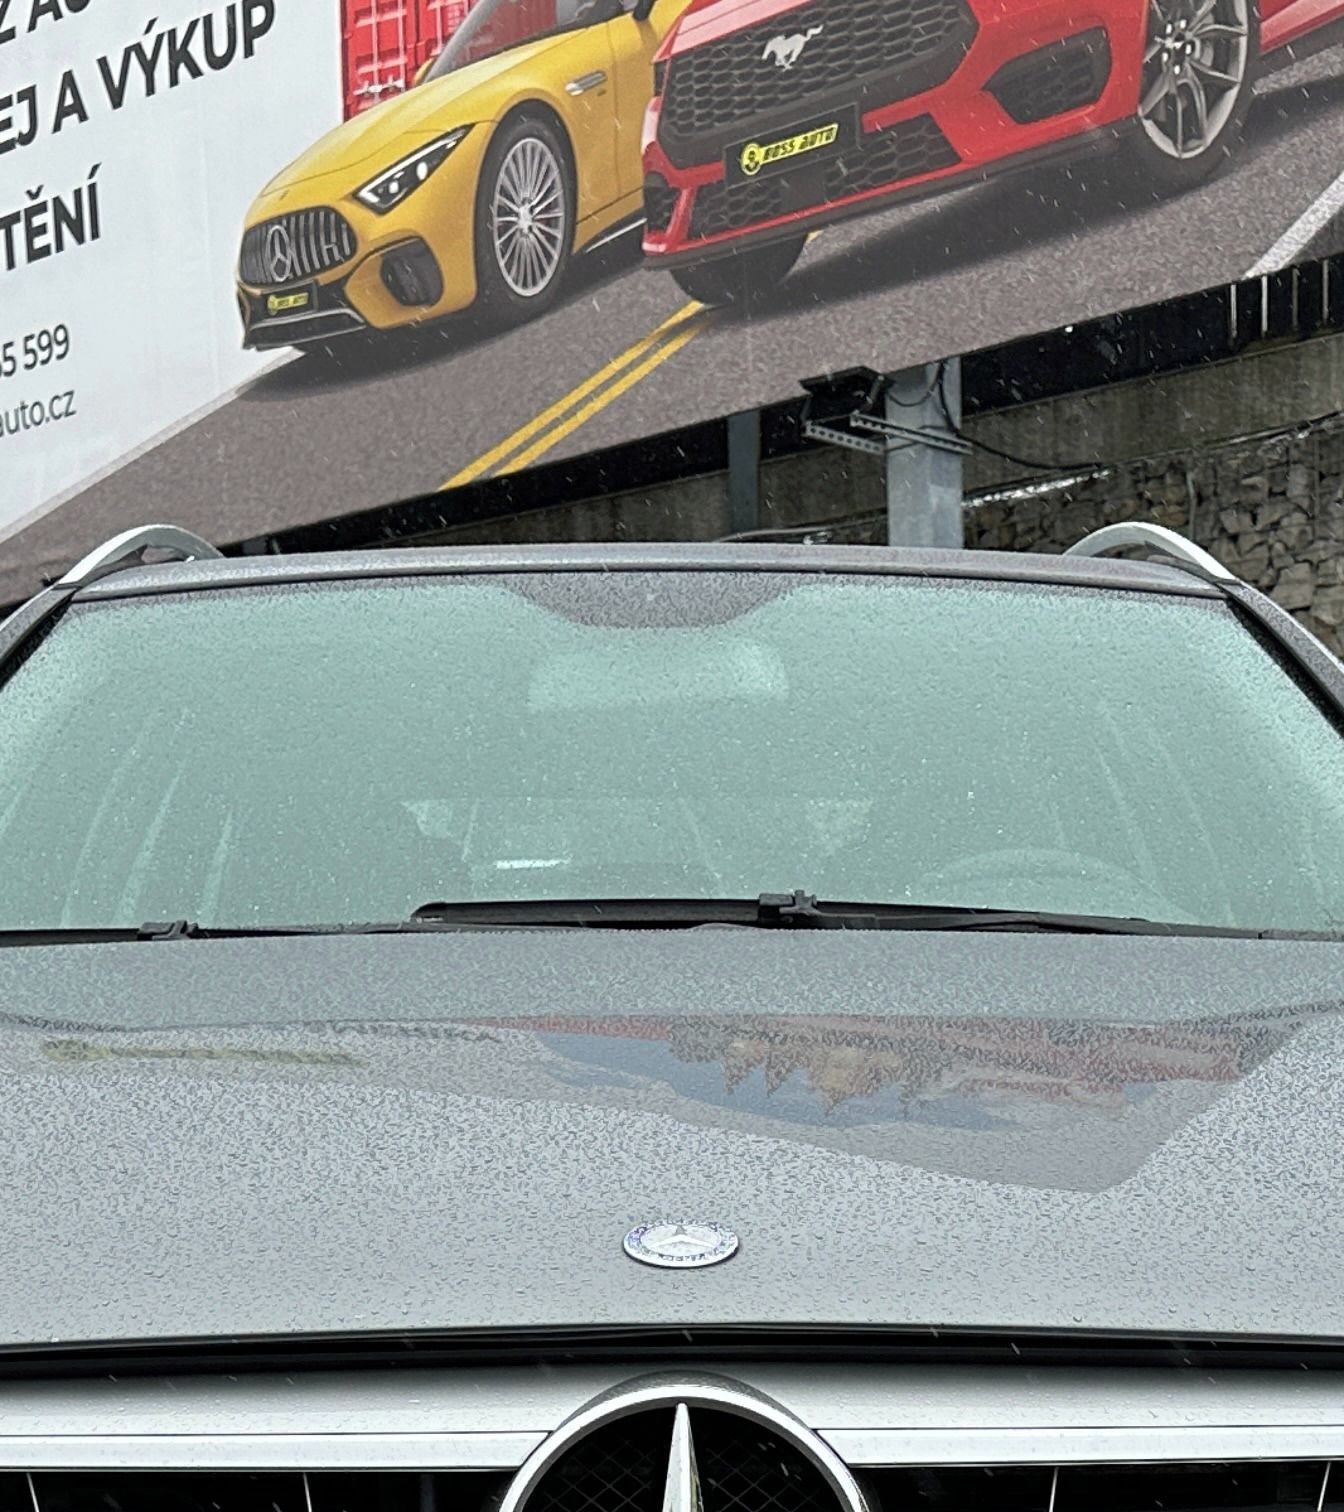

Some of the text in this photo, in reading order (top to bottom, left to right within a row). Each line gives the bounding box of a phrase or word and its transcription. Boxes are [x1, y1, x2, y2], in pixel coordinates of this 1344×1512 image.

[51, 69, 89, 134] A
[96, 0, 276, 110] VÝKUP
[23, 324, 70, 370] 599
